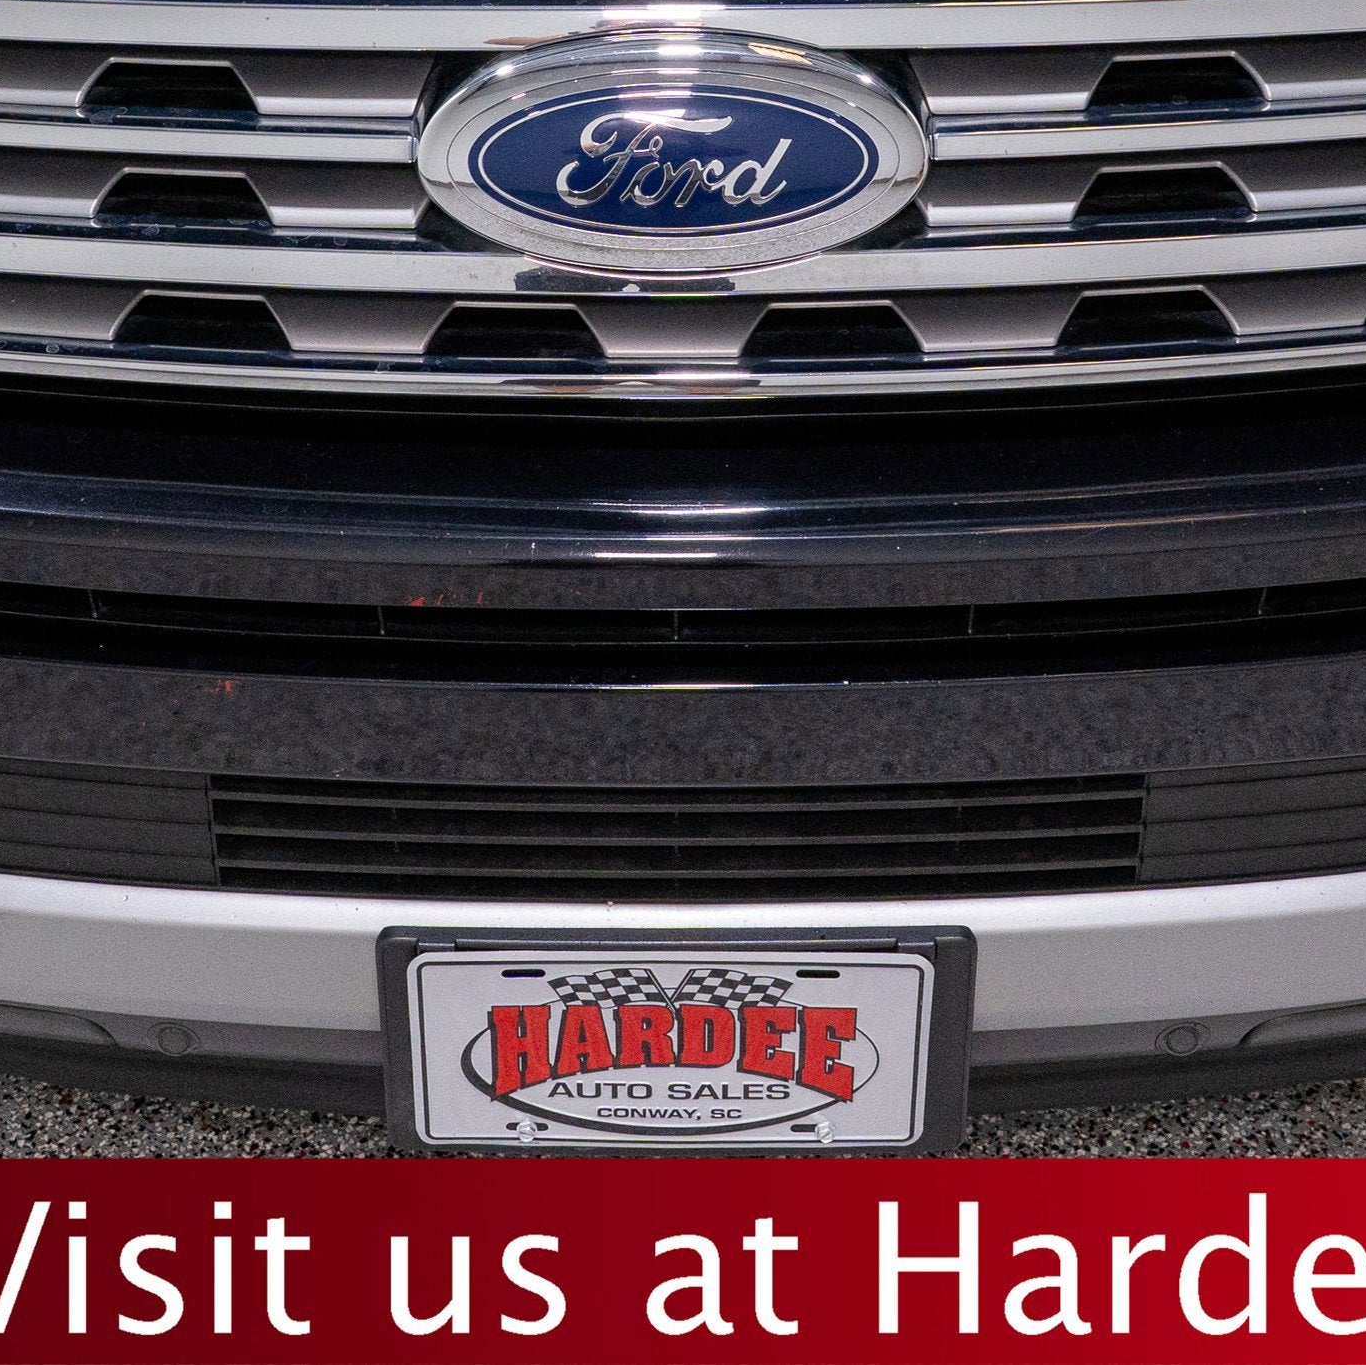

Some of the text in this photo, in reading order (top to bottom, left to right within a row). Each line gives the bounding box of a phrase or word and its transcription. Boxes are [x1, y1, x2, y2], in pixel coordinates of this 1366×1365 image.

[556, 109, 792, 208] Ford
[486, 1004, 857, 1102] HARDEE
[546, 1081, 791, 1102] AUTO SALES
[596, 1107, 742, 1121] CONWAY, SC
